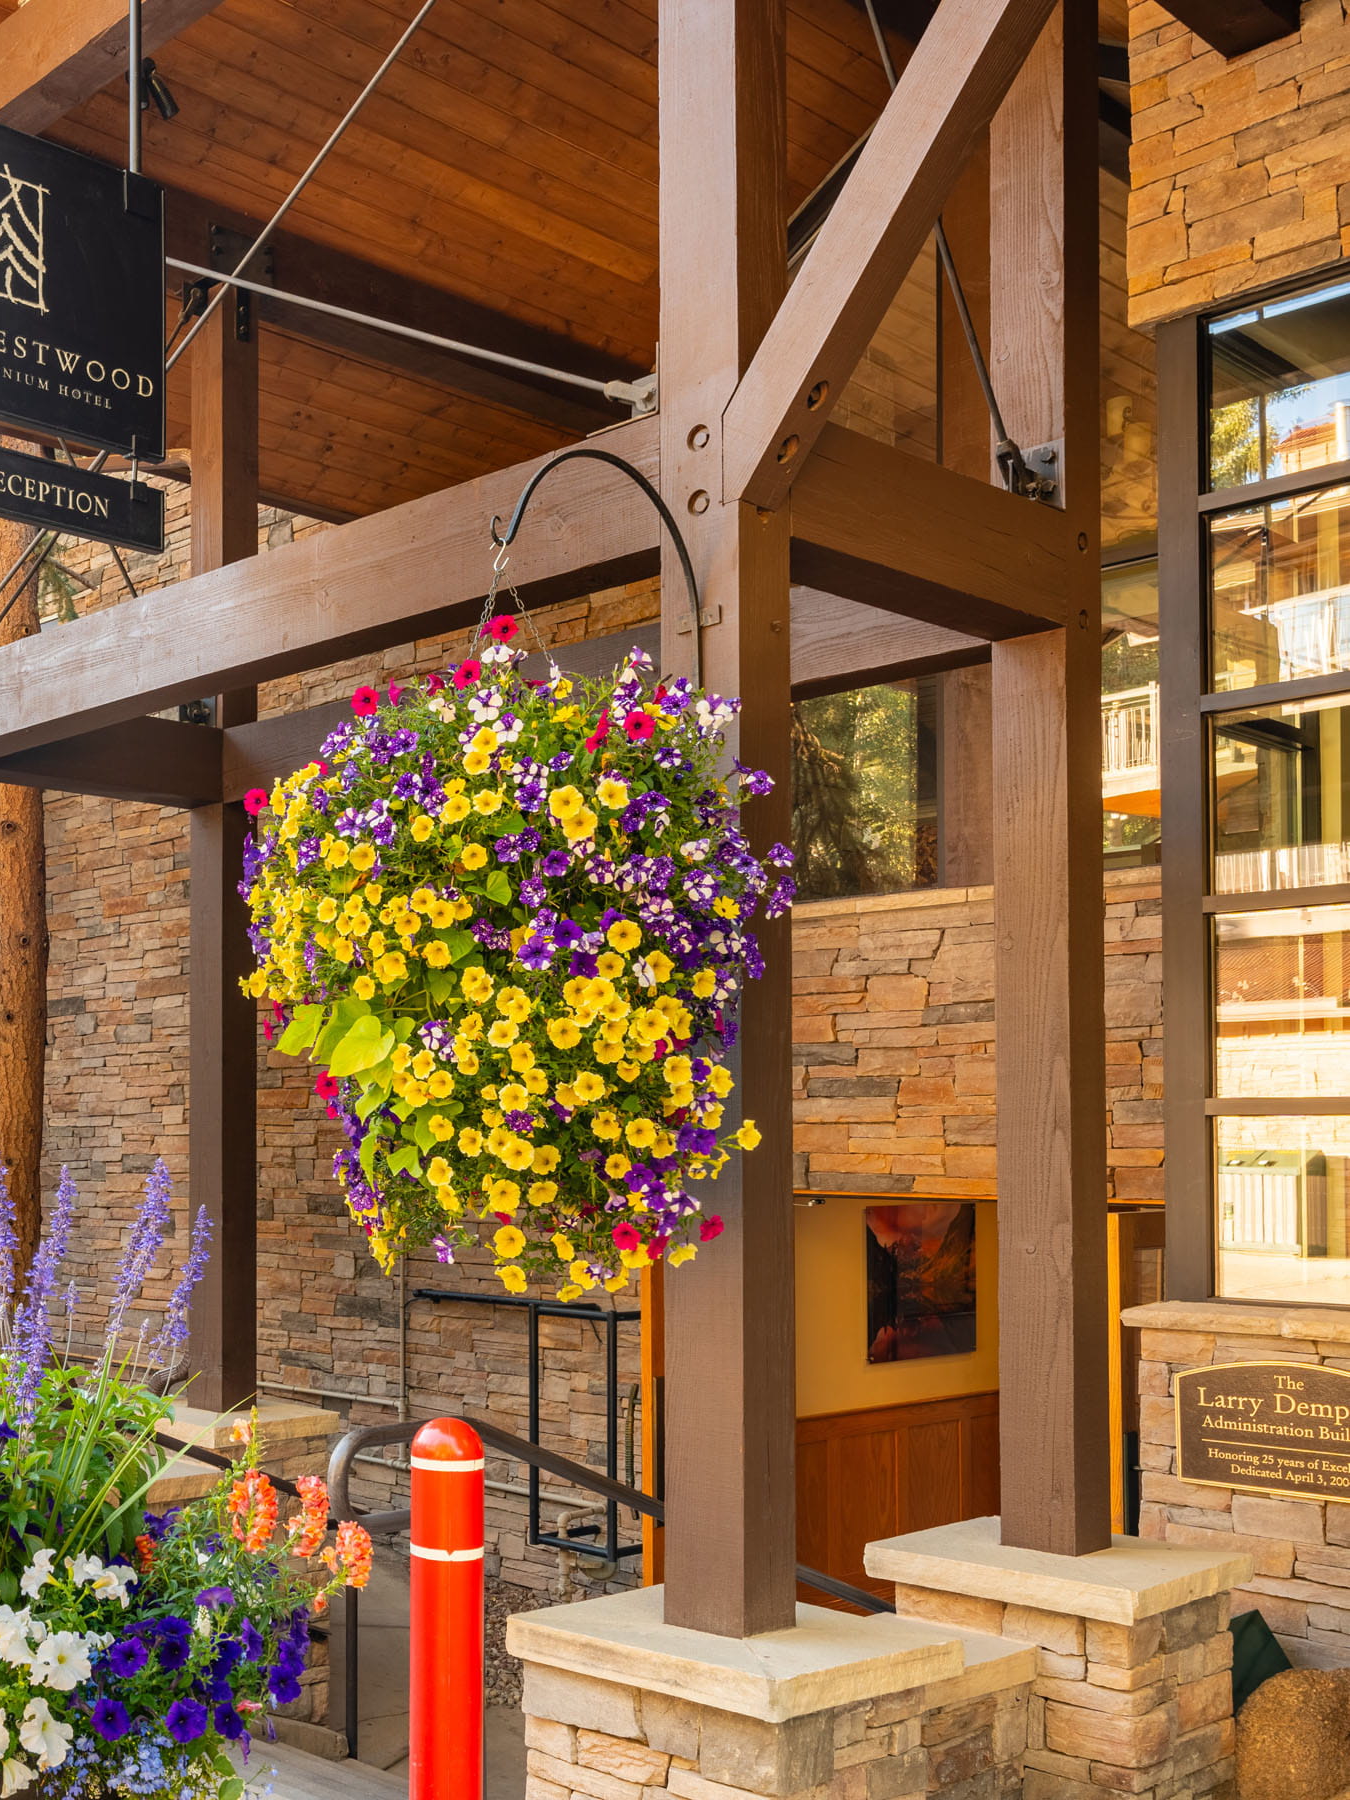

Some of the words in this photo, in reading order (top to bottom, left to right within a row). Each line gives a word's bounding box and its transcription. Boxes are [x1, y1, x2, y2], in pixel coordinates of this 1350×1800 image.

[58, 384, 112, 410] HOTEL
[1274, 1375, 1305, 1391] The
[1197, 1387, 1264, 1416] Larry
[1202, 1415, 1314, 1438] Administration
[1207, 1448, 1260, 1465] Honoring
[1262, 1454, 1275, 1464] 25
[1277, 1458, 1305, 1468] years
[1307, 1459, 1320, 1470] of
[1231, 1464, 1282, 1479] Dedicated
[1285, 1471, 1314, 1484] April
[1316, 1474, 1327, 1486] 3,
[1330, 1476, 1350, 1487] 200
